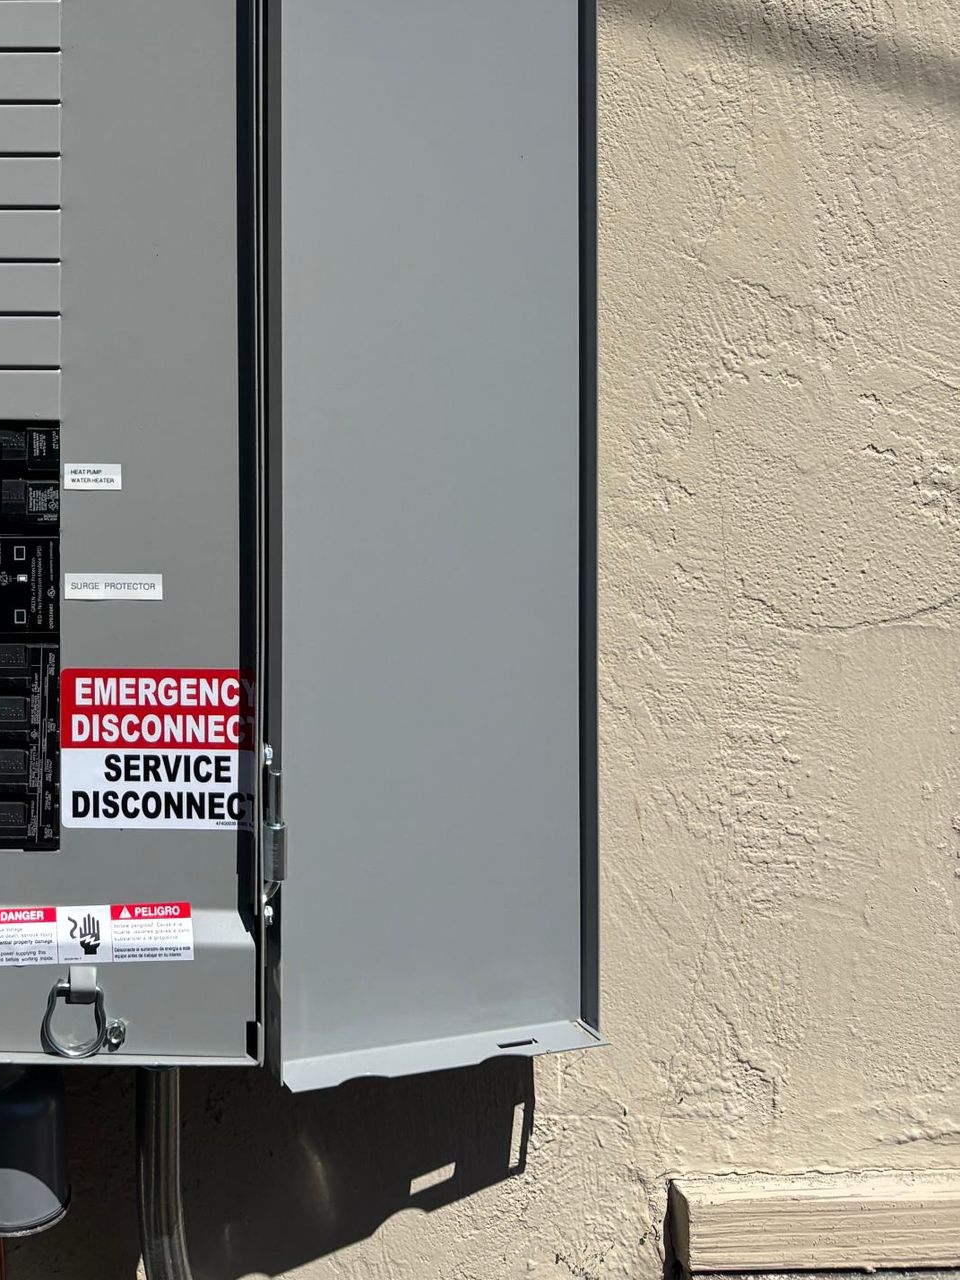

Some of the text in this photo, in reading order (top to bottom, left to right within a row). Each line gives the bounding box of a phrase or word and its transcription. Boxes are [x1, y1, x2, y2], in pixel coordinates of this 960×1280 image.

[70, 582, 156, 590] SURGE PROTECTOR
[104, 754, 231, 783] SERVICE
[0, 910, 44, 921] DANGER
[134, 906, 180, 917] PELIGRO
